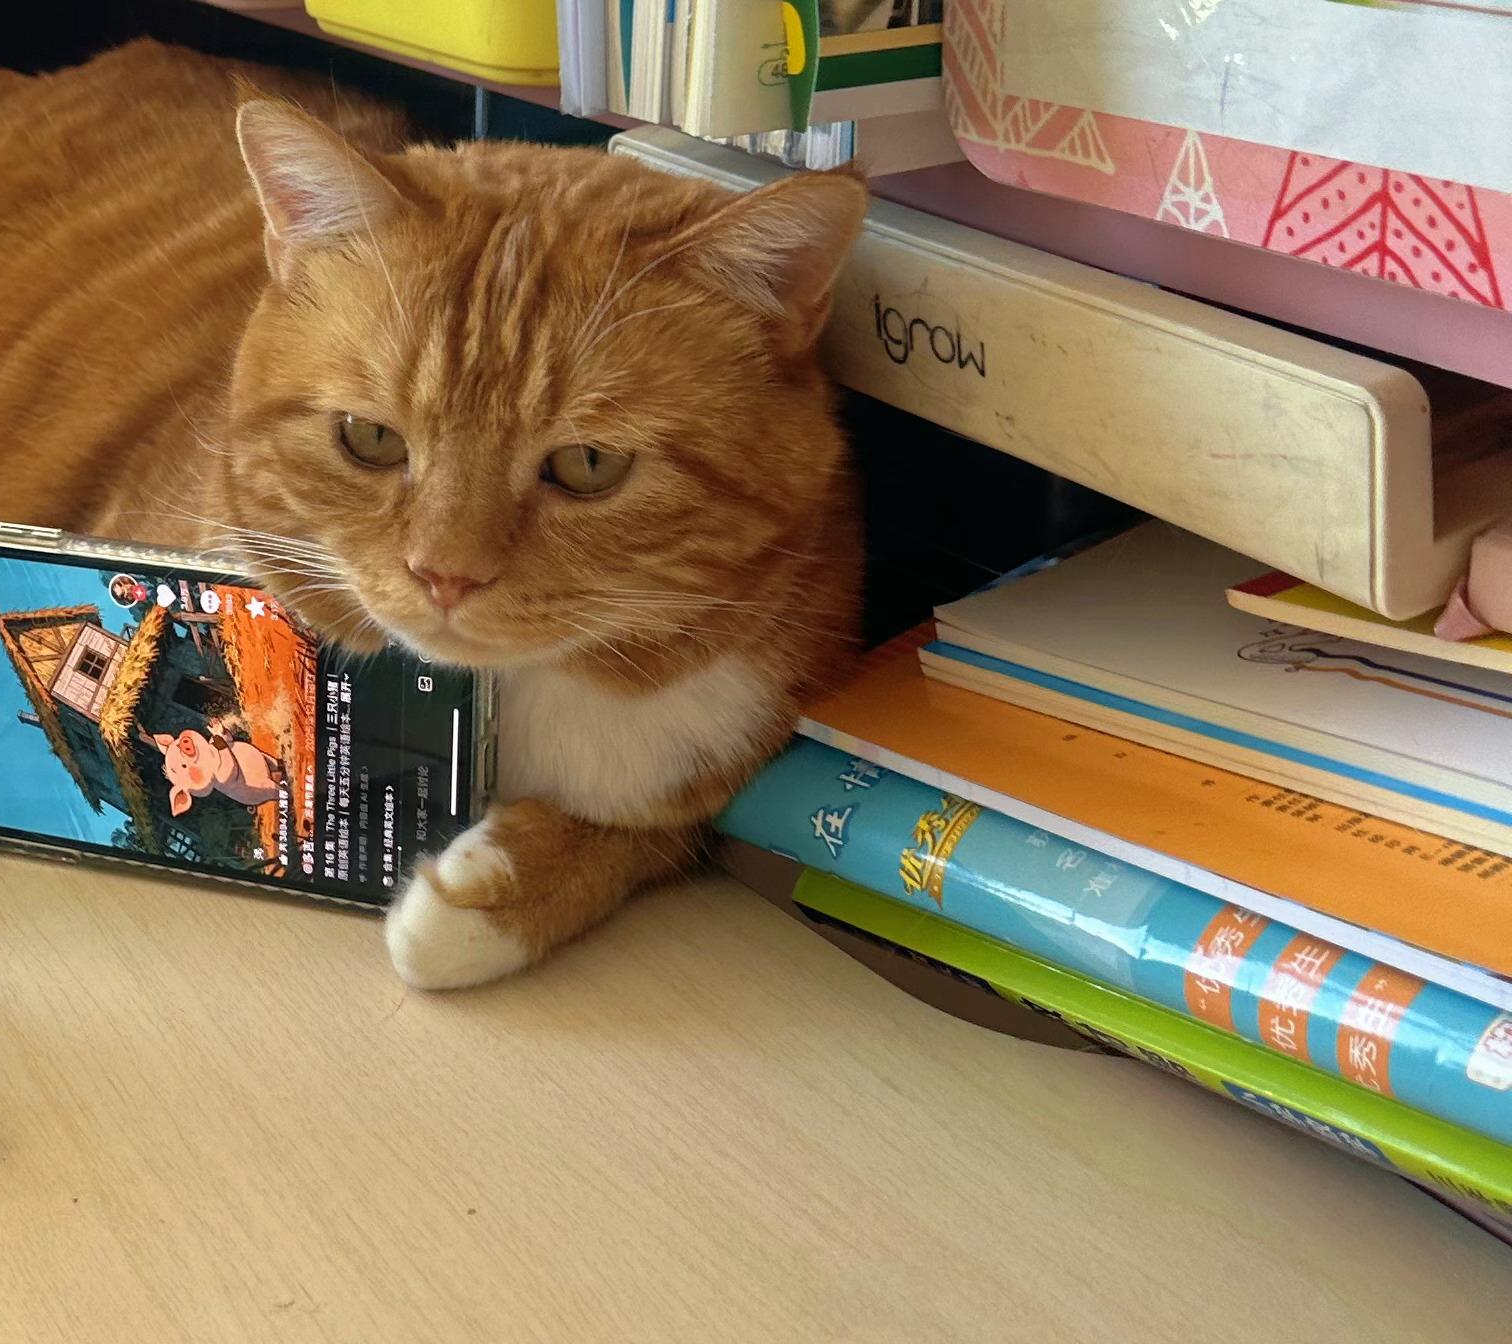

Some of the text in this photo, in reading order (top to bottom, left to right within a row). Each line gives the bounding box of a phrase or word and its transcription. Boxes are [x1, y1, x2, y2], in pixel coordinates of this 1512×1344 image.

[327, 680, 339, 725] 三只小猪
[340, 681, 352, 704] 展开
[327, 736, 338, 757] Pigs
[326, 762, 337, 783] Little
[326, 791, 336, 817] Three
[326, 817, 336, 833] The
[337, 818, 349, 882] 原创英语绘本
